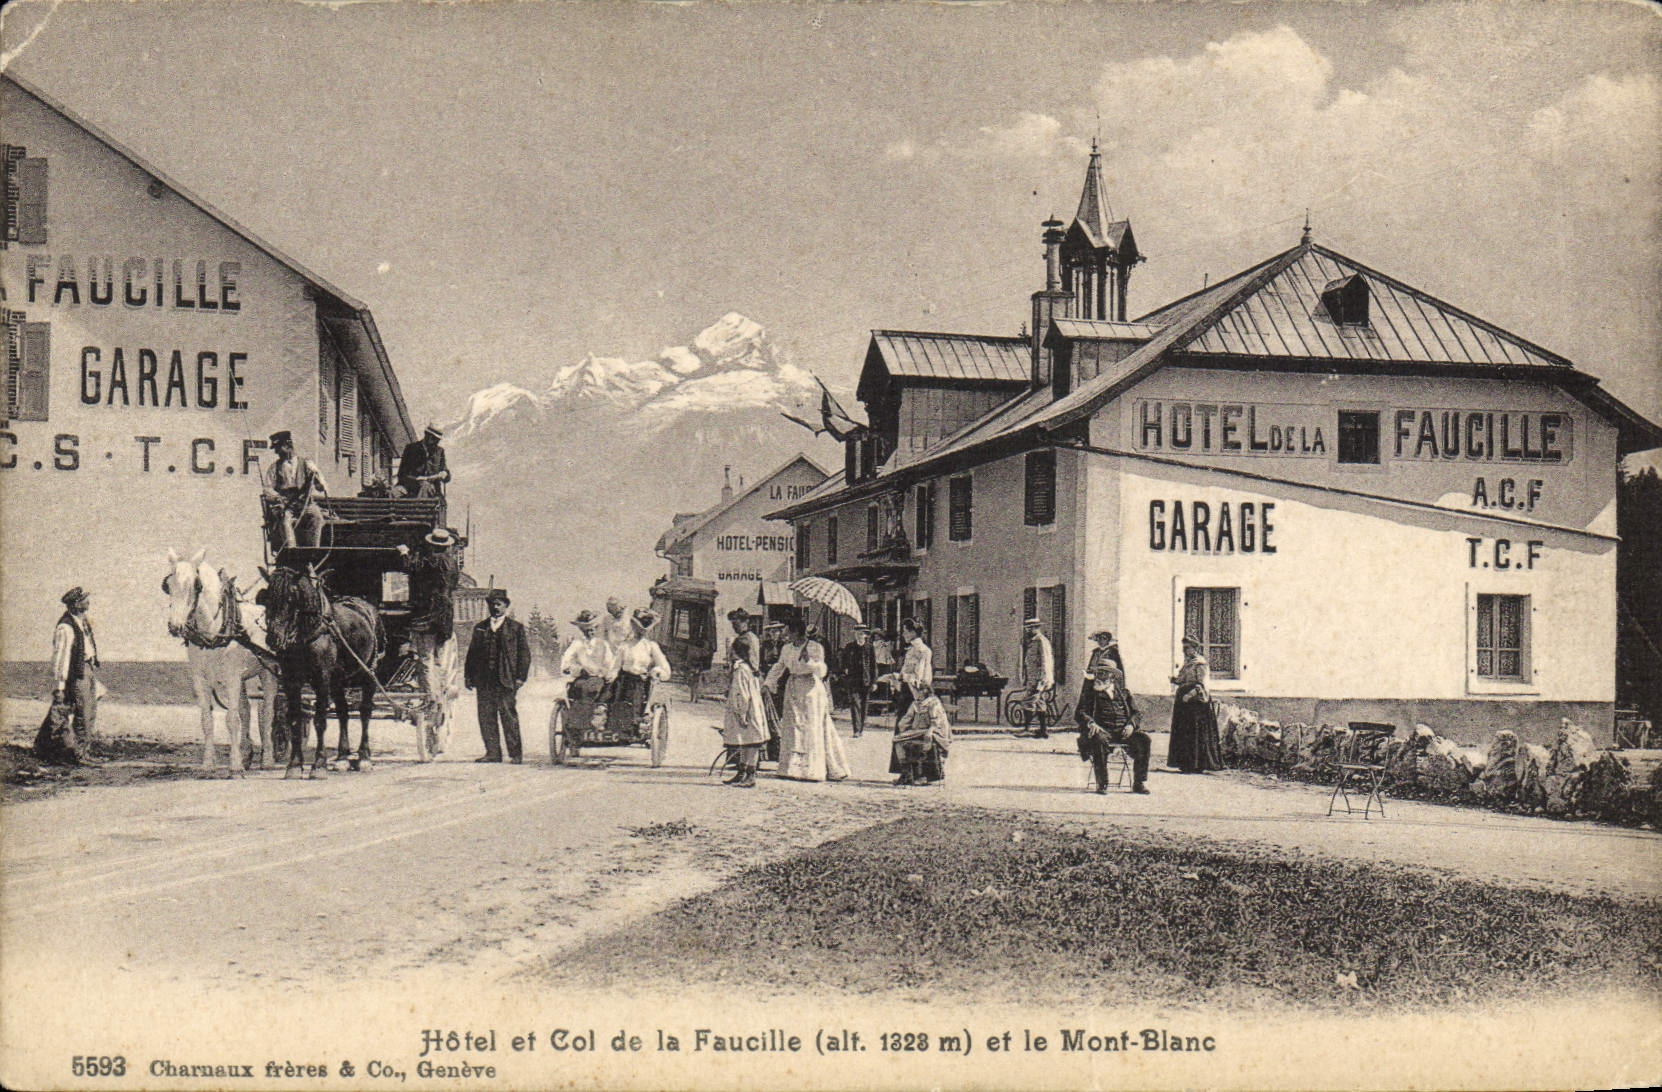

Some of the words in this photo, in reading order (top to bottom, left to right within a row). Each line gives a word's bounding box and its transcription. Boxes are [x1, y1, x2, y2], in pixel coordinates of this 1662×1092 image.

[27, 254, 242, 312] FAUCILLE
[80, 346, 249, 410] GARAGE
[1140, 401, 1269, 453] HOTEL
[1269, 424, 1295, 452] DE
[1301, 426, 1326, 454] LA
[1394, 410, 1562, 461] FAUCILLE
[769, 485, 782, 500] LA
[1472, 477, 1543, 512] A.C.F
[1149, 499, 1277, 555] GARAGE
[1466, 538, 1543, 571] T.C.F
